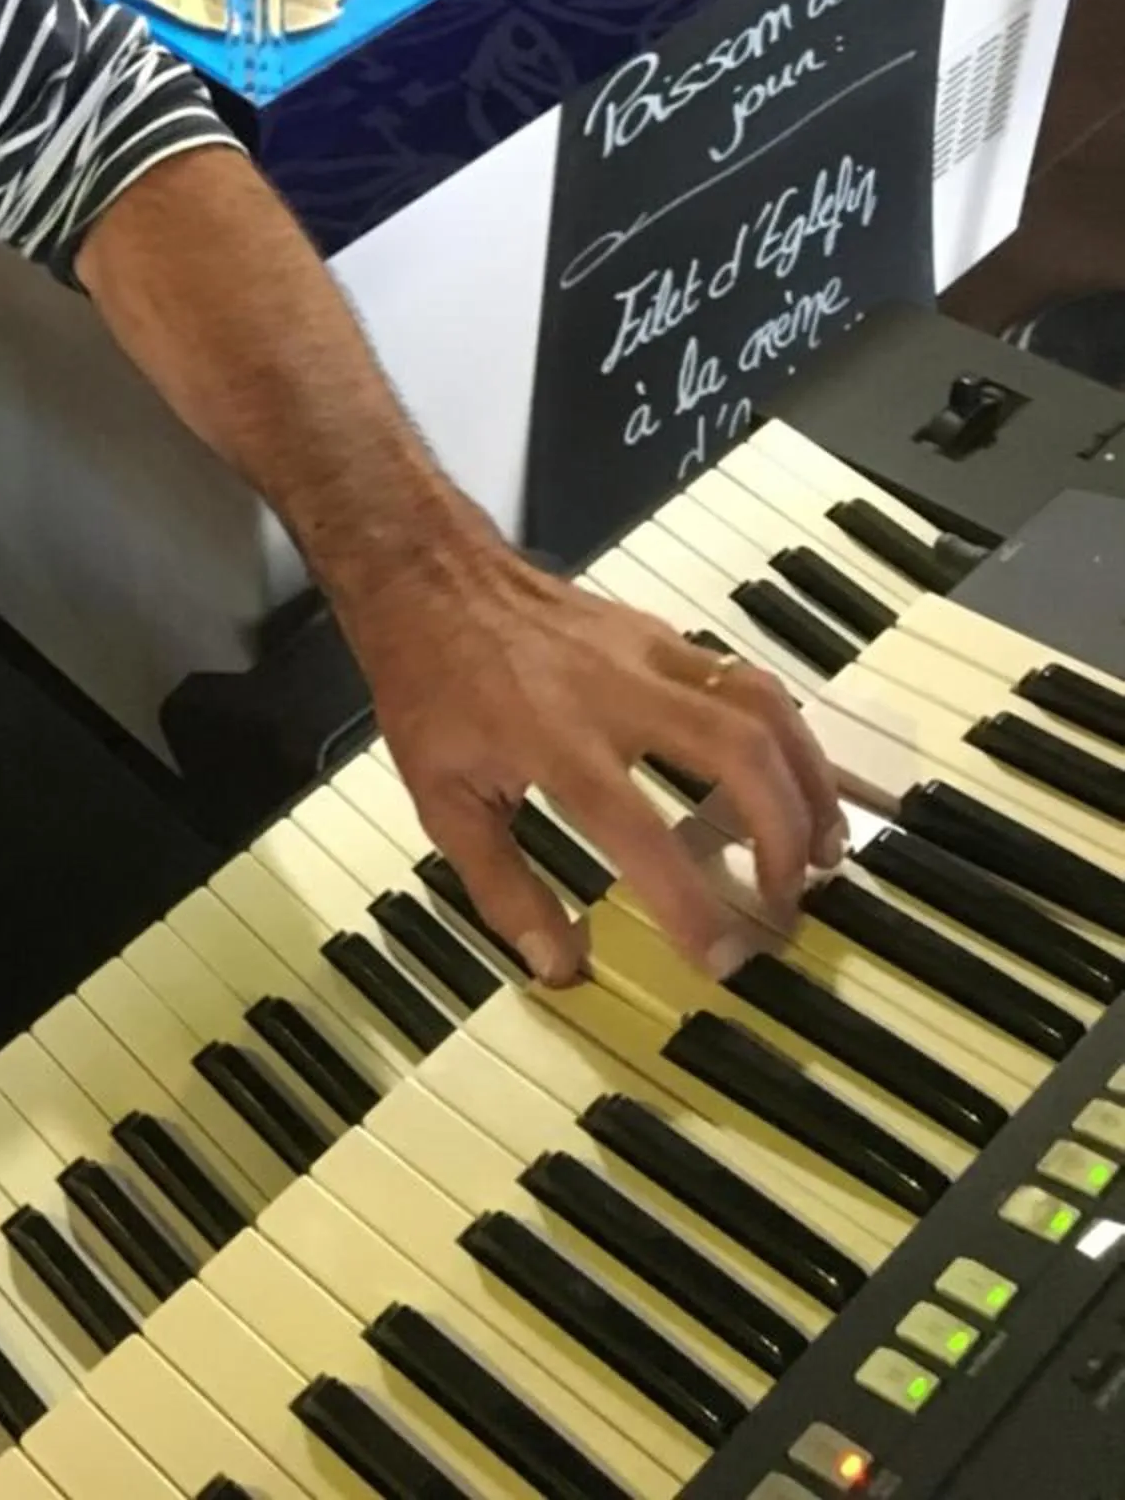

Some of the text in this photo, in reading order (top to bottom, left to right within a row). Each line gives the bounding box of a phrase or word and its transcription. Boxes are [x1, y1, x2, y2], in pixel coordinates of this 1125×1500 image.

[601, 258, 703, 374] Filet
[623, 381, 662, 445] à
[674, 337, 727, 414] la
